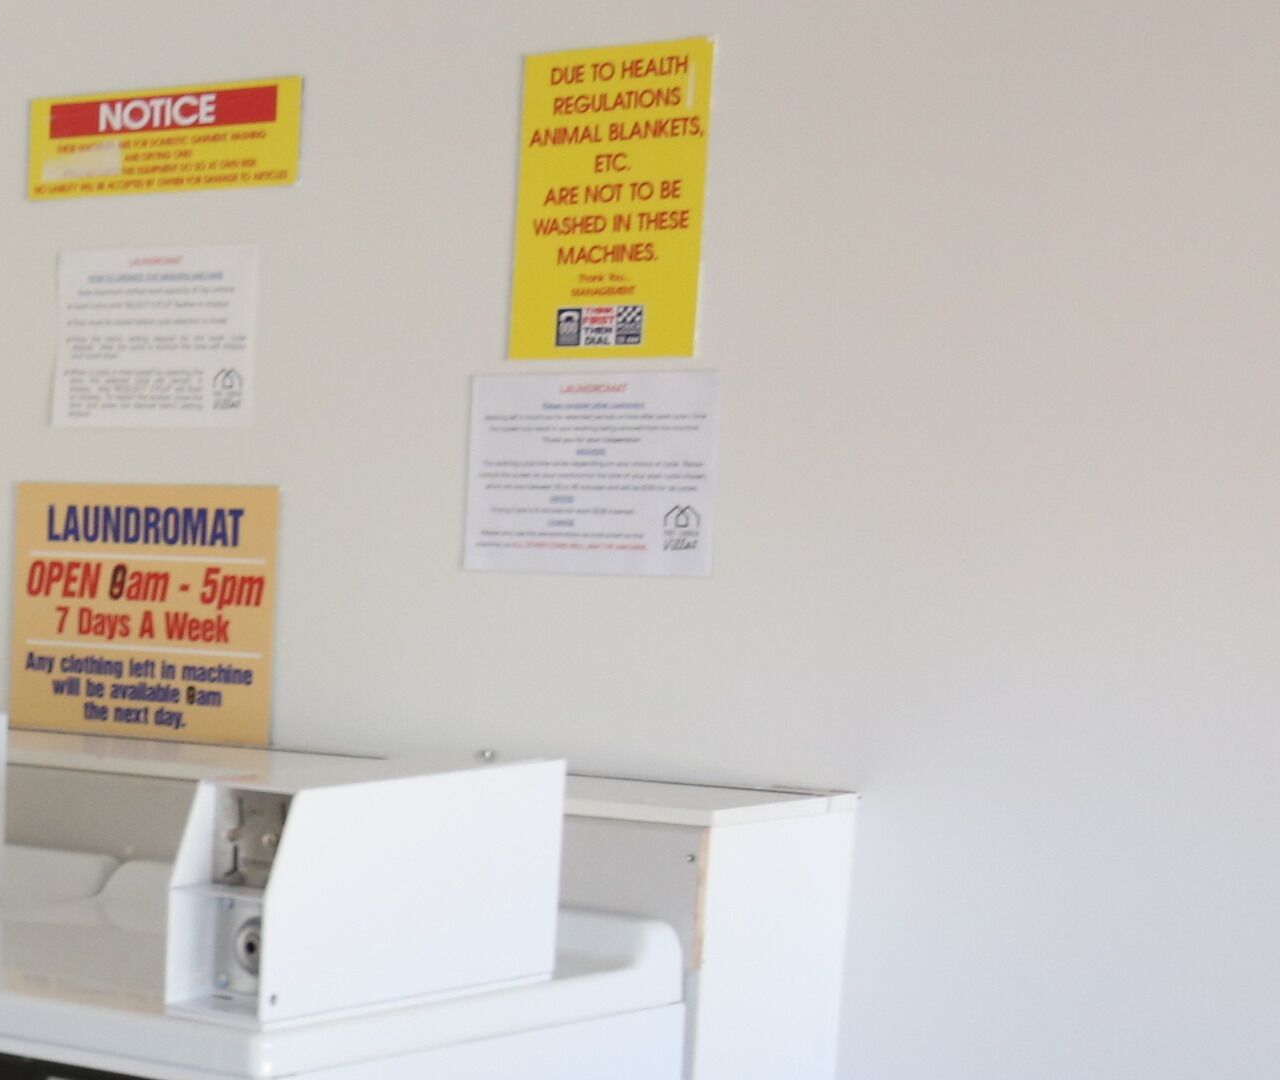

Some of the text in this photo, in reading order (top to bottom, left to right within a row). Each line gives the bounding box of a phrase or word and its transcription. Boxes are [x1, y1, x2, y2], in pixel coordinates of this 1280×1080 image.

[550, 54, 689, 86] DUE TO HEALTH
[98, 93, 217, 133] NOTICE
[552, 87, 681, 116] REGULATIONS
[528, 116, 704, 148] ANIMAL BLANKETS,
[594, 152, 631, 174] ETC.
[543, 179, 682, 206] ARE NOT TO BE
[533, 210, 690, 237] WASHED IN THESE
[557, 242, 658, 266] MACHINES.
[46, 504, 244, 547] LAUNDROMAT
[26, 560, 102, 599] OPEN
[179, 584, 190, 592] -
[199, 567, 265, 610] 5pm
[56, 606, 230, 644] 7 Days A Week
[25, 651, 253, 686] Any clothing left in machine
[52, 677, 80, 696] will
[86, 679, 104, 699] be
[110, 681, 180, 704] available
[84, 702, 186, 729] the next day.
